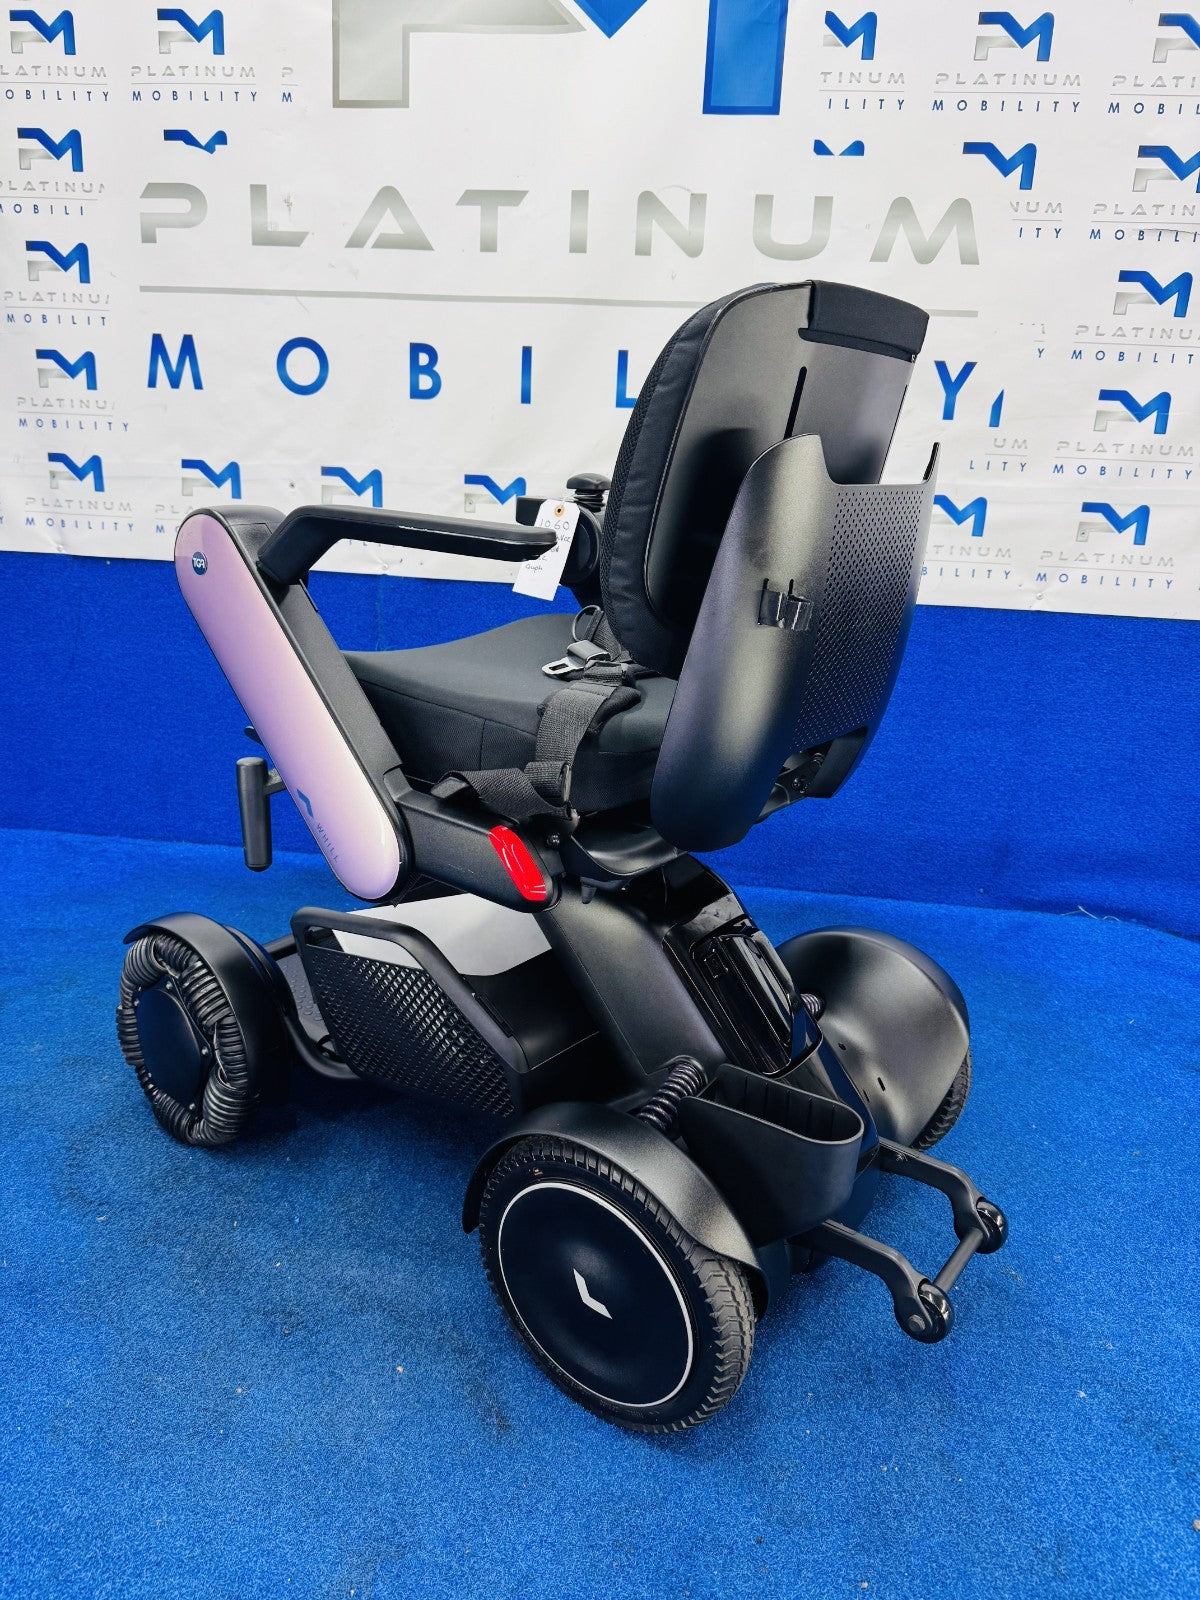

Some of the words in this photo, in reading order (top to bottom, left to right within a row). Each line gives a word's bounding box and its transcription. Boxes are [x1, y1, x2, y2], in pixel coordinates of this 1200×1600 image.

[131, 65, 256, 78] PLATINUM
[820, 71, 905, 84] TINUM
[935, 72, 1081, 87] PLATINUM
[5, 89, 109, 101] OBILITY
[132, 90, 257, 102] MOBILITY
[828, 98, 905, 110] ILITY
[932, 99, 1080, 113] MOBILITY
[0, 180, 105, 194] LATINU
[139, 182, 980, 265] PLATINUM
[6, 313, 106, 326] MOBILIT
[1074, 325, 1200, 340] PLATINU
[147, 333, 977, 421] MOBILY
[17, 397, 115, 410] PLATINU
[19, 418, 129, 431] MOBILITY
[1056, 441, 1193, 456] PLATINUM
[1053, 463, 1192, 480] MOBILITY
[25, 496, 132, 512] PLATINUM
[26, 517, 133, 532] MOBILITY
[1040, 550, 1174, 567] PLATINUM
[1036, 572, 1173, 589] MOBILITY
